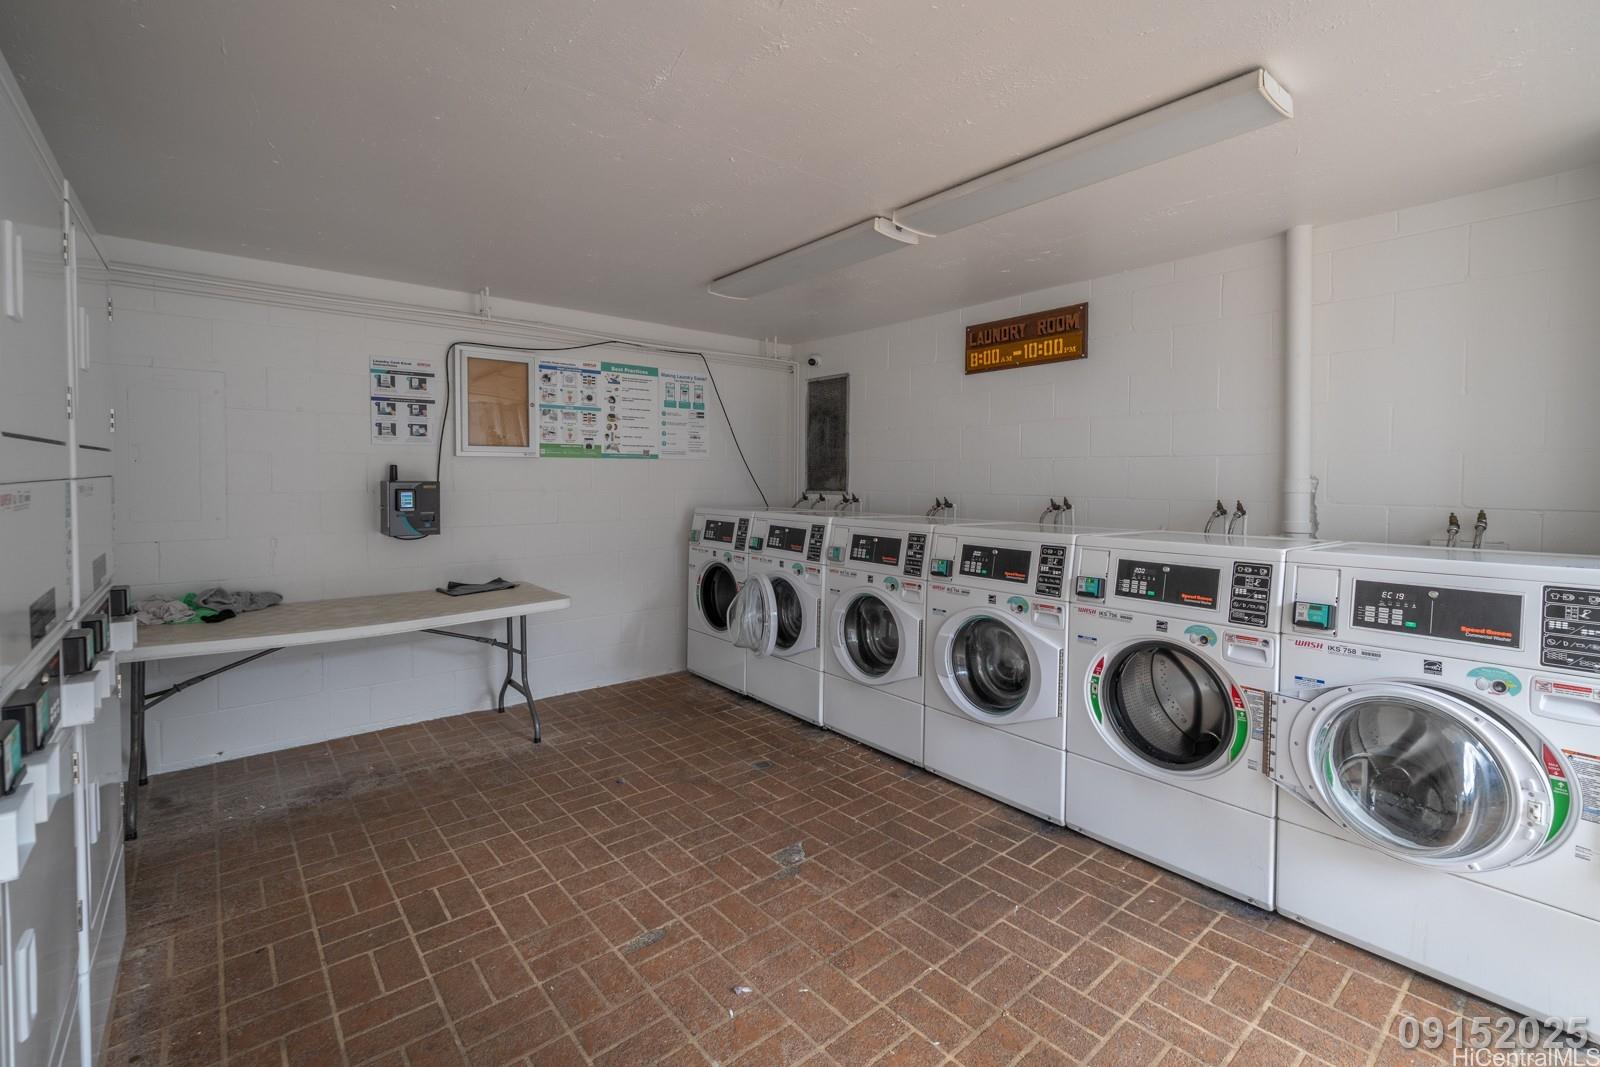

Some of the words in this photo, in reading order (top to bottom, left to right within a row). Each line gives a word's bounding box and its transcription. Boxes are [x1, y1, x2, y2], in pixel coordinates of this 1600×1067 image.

[969, 322, 1026, 347] LAUNDRY
[1037, 312, 1080, 336] ROOM
[624, 367, 649, 375] Practices
[1460, 626, 1486, 635] Speed
[1486, 628, 1513, 638] Queen
[1294, 639, 1324, 650] WASH
[1327, 645, 1341, 653] IKS
[1343, 646, 1357, 655] 758
